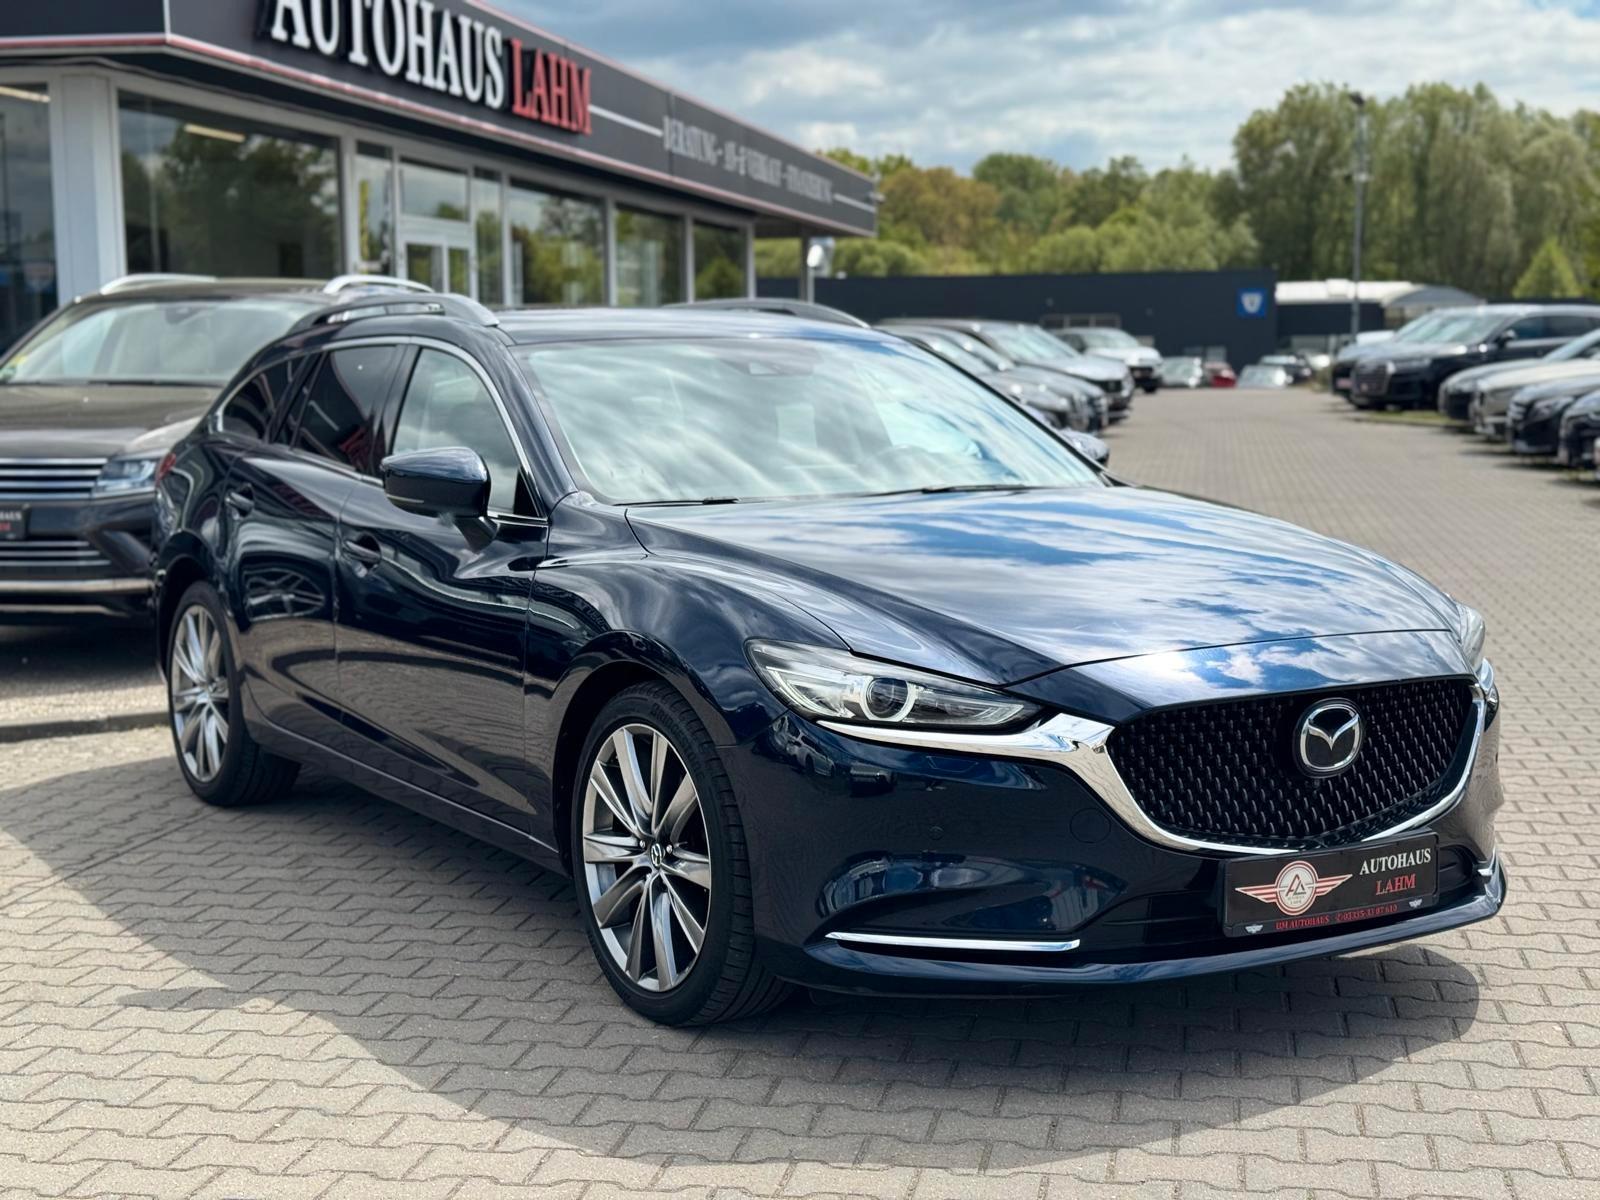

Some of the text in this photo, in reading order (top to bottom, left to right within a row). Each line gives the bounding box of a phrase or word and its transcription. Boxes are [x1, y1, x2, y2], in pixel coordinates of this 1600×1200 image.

[271, 0, 592, 136] AUTOHAUS LAHM
[1359, 848, 1432, 876] AUTOHAUS
[1375, 873, 1416, 896] LAHM
